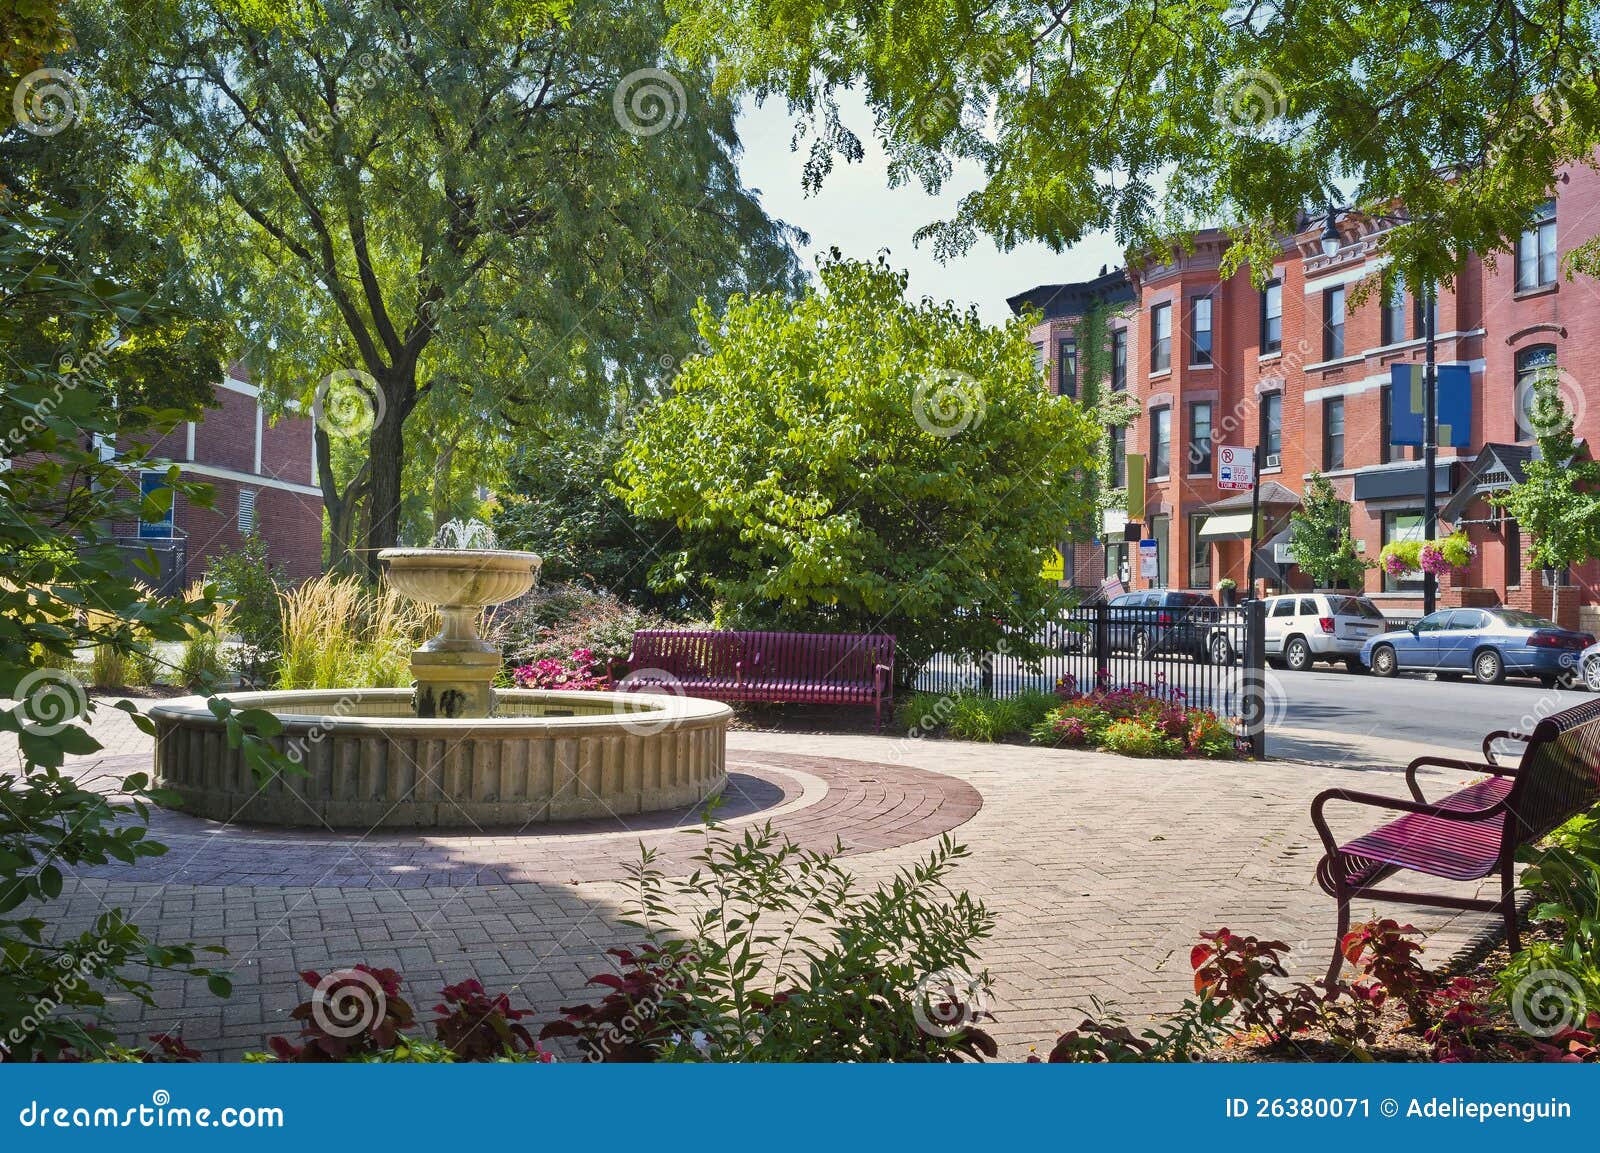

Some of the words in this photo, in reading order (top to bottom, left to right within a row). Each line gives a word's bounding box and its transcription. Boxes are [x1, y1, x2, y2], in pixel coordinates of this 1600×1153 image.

[1233, 466, 1246, 475] BUS
[1233, 474, 1249, 482] STOP
[1235, 482, 1249, 490] ZONE
